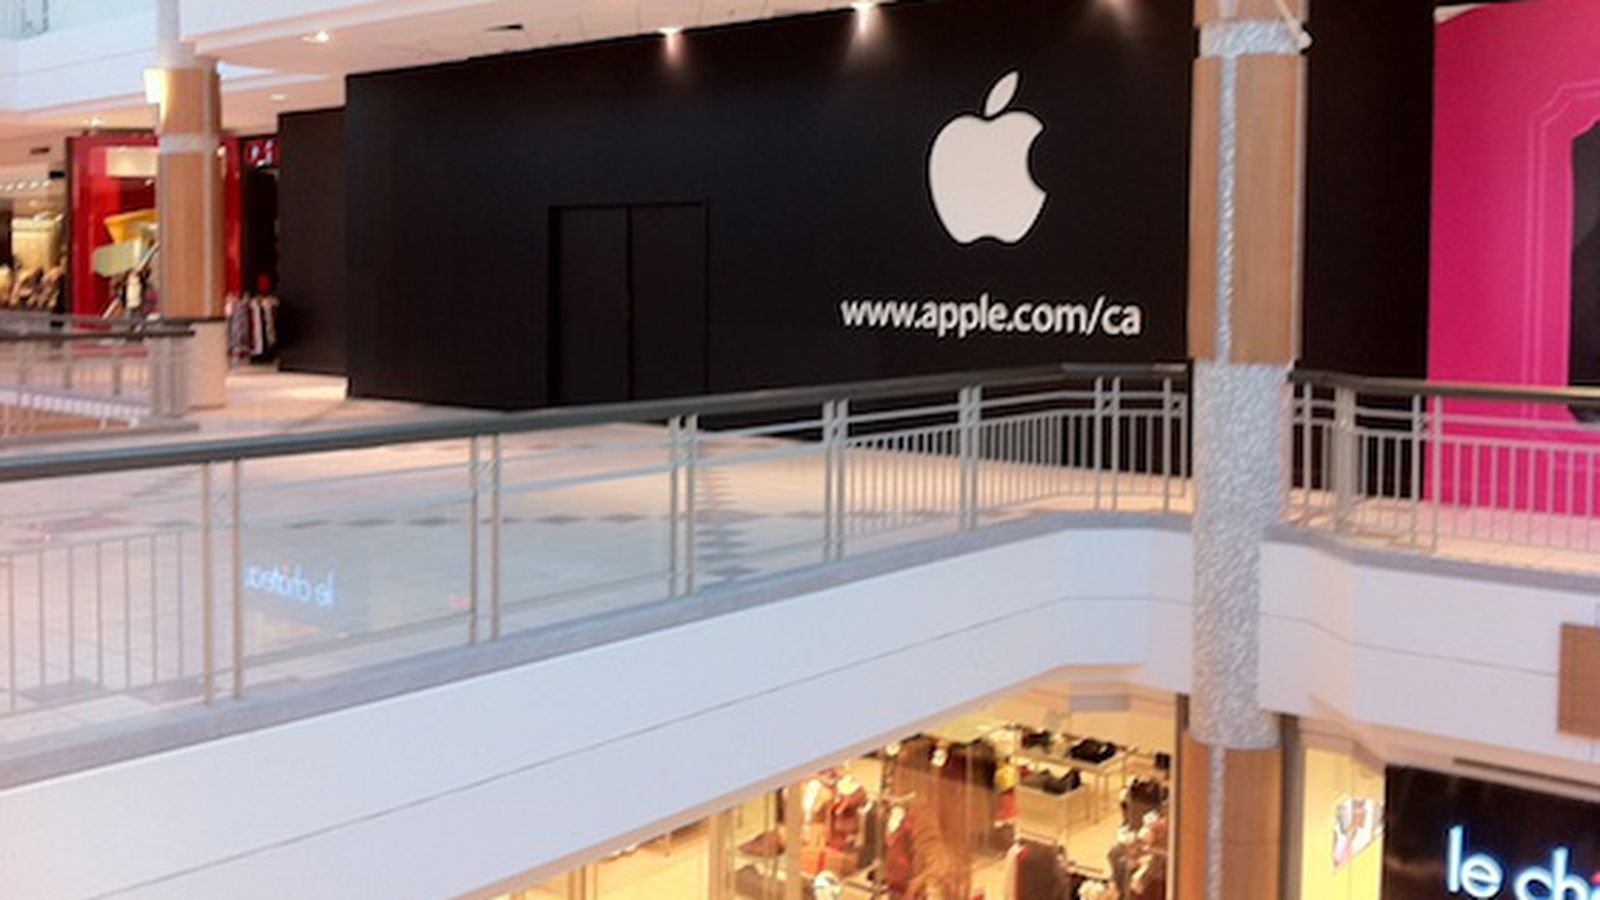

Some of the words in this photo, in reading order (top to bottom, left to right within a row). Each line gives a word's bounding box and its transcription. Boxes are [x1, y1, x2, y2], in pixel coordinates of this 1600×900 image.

[841, 293, 1141, 338] www.apple.com/ca
[1447, 825, 1503, 898] le
[1513, 846, 1600, 900] ch
